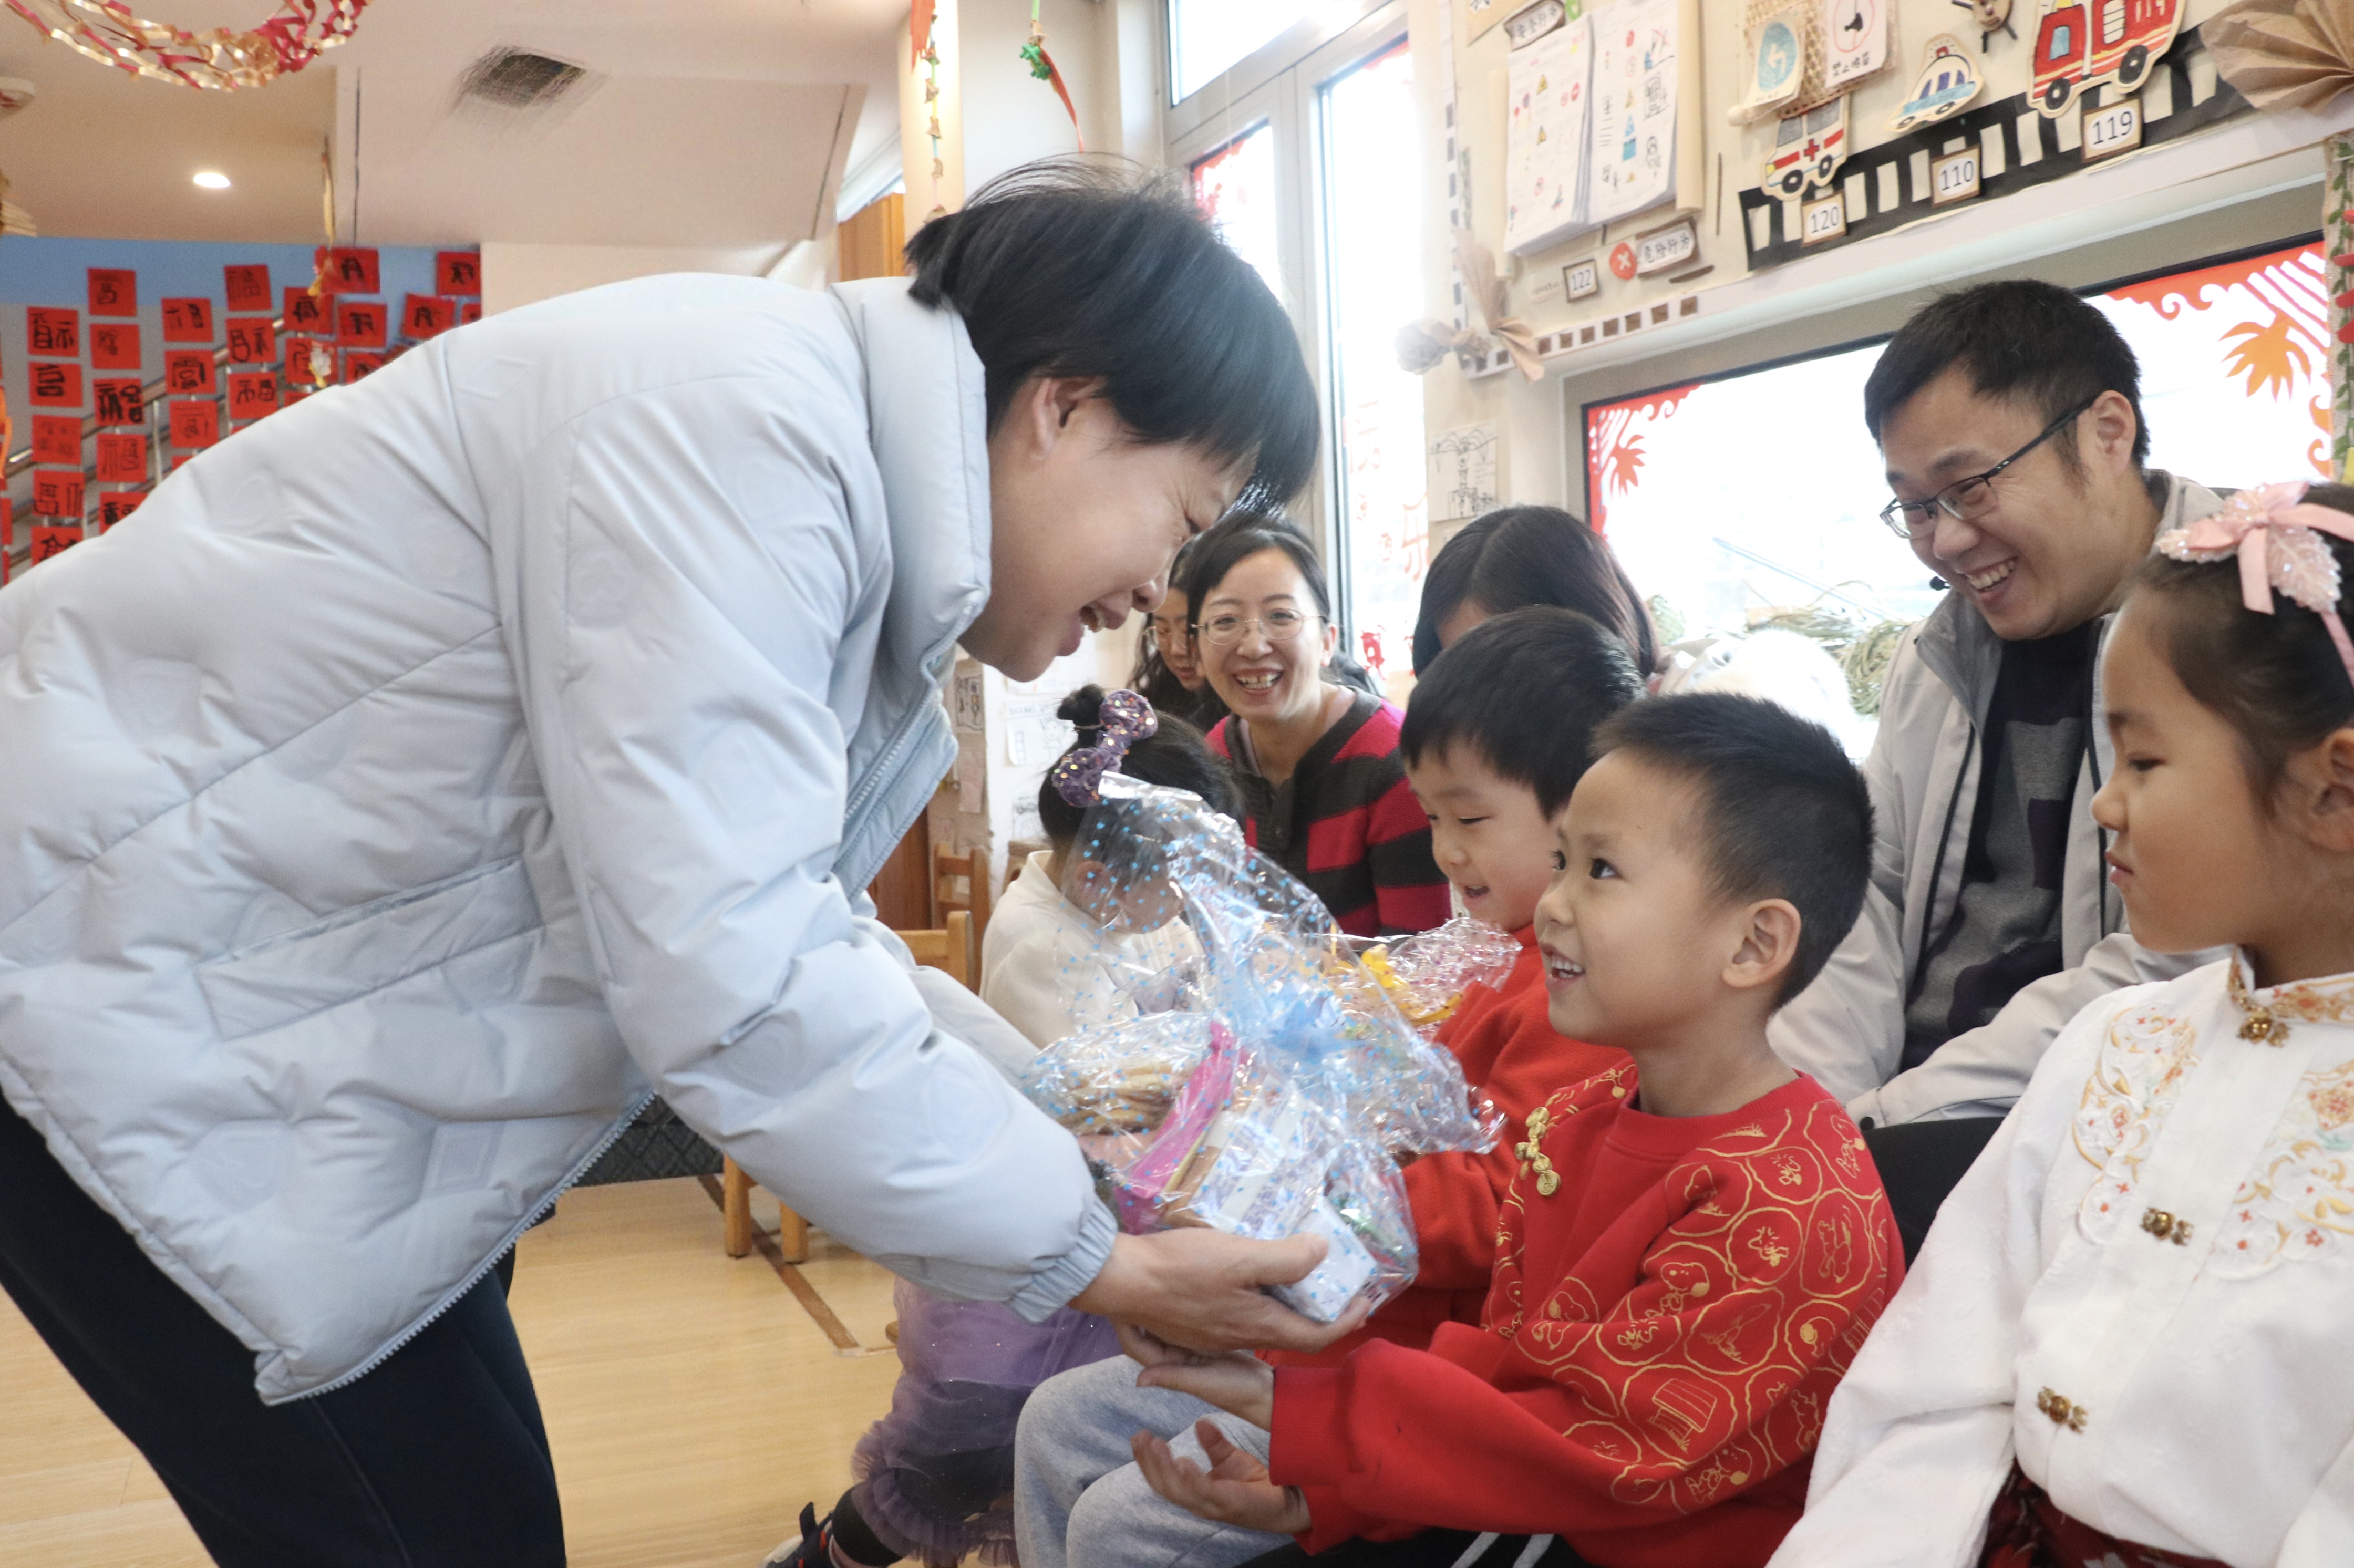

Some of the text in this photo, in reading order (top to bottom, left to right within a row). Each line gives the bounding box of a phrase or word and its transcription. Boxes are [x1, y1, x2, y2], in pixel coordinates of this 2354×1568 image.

[2092, 110, 2132, 146] 119
[1939, 160, 1974, 191] 110
[1810, 205, 1839, 234] 120
[1571, 269, 1591, 291] 122
